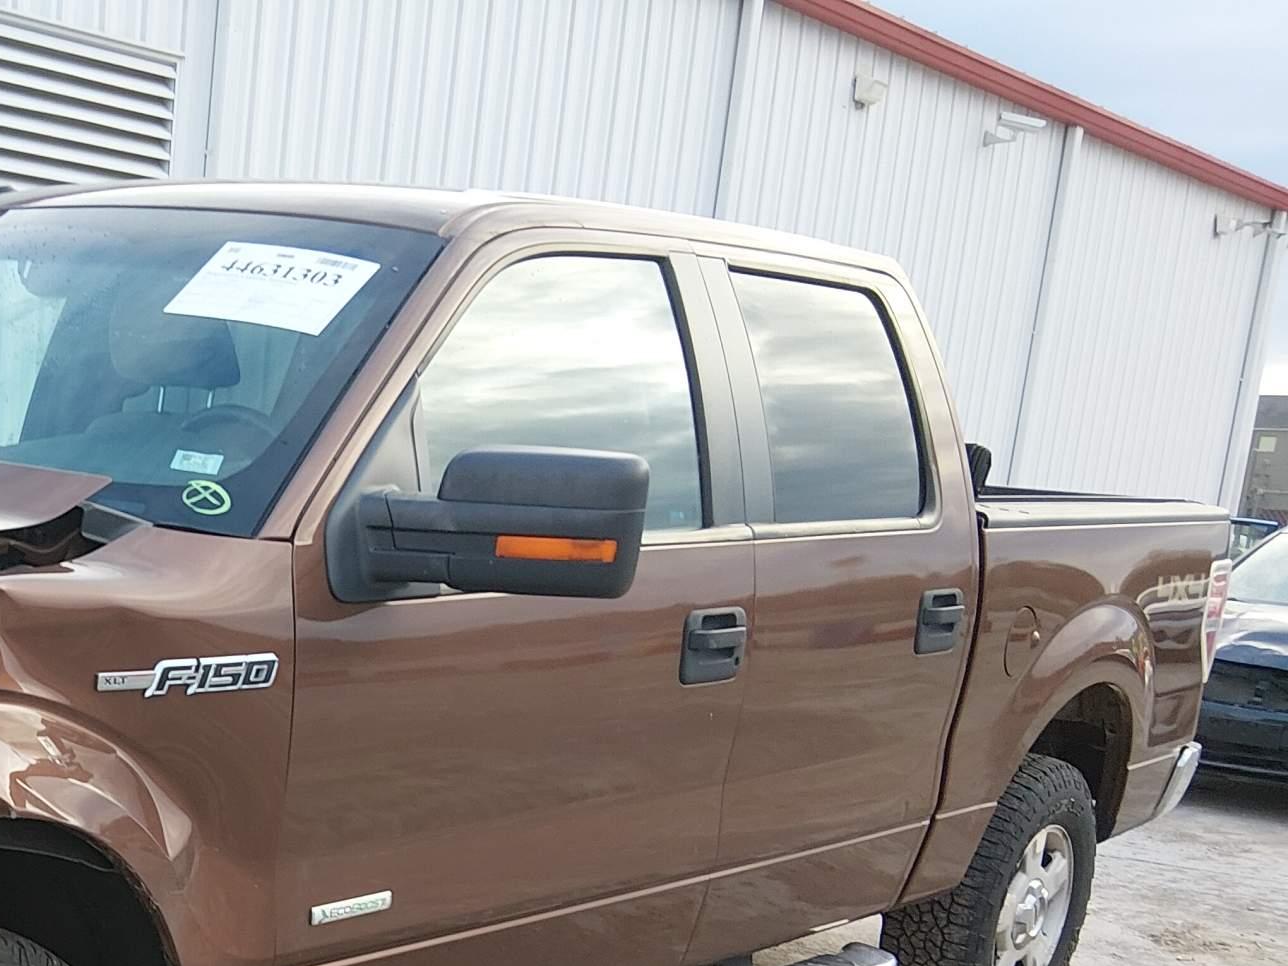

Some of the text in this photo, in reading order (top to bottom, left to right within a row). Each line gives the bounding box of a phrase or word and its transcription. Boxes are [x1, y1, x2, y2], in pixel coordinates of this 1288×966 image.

[221, 258, 343, 287] 44631303
[103, 654, 279, 697] XLT F-150
